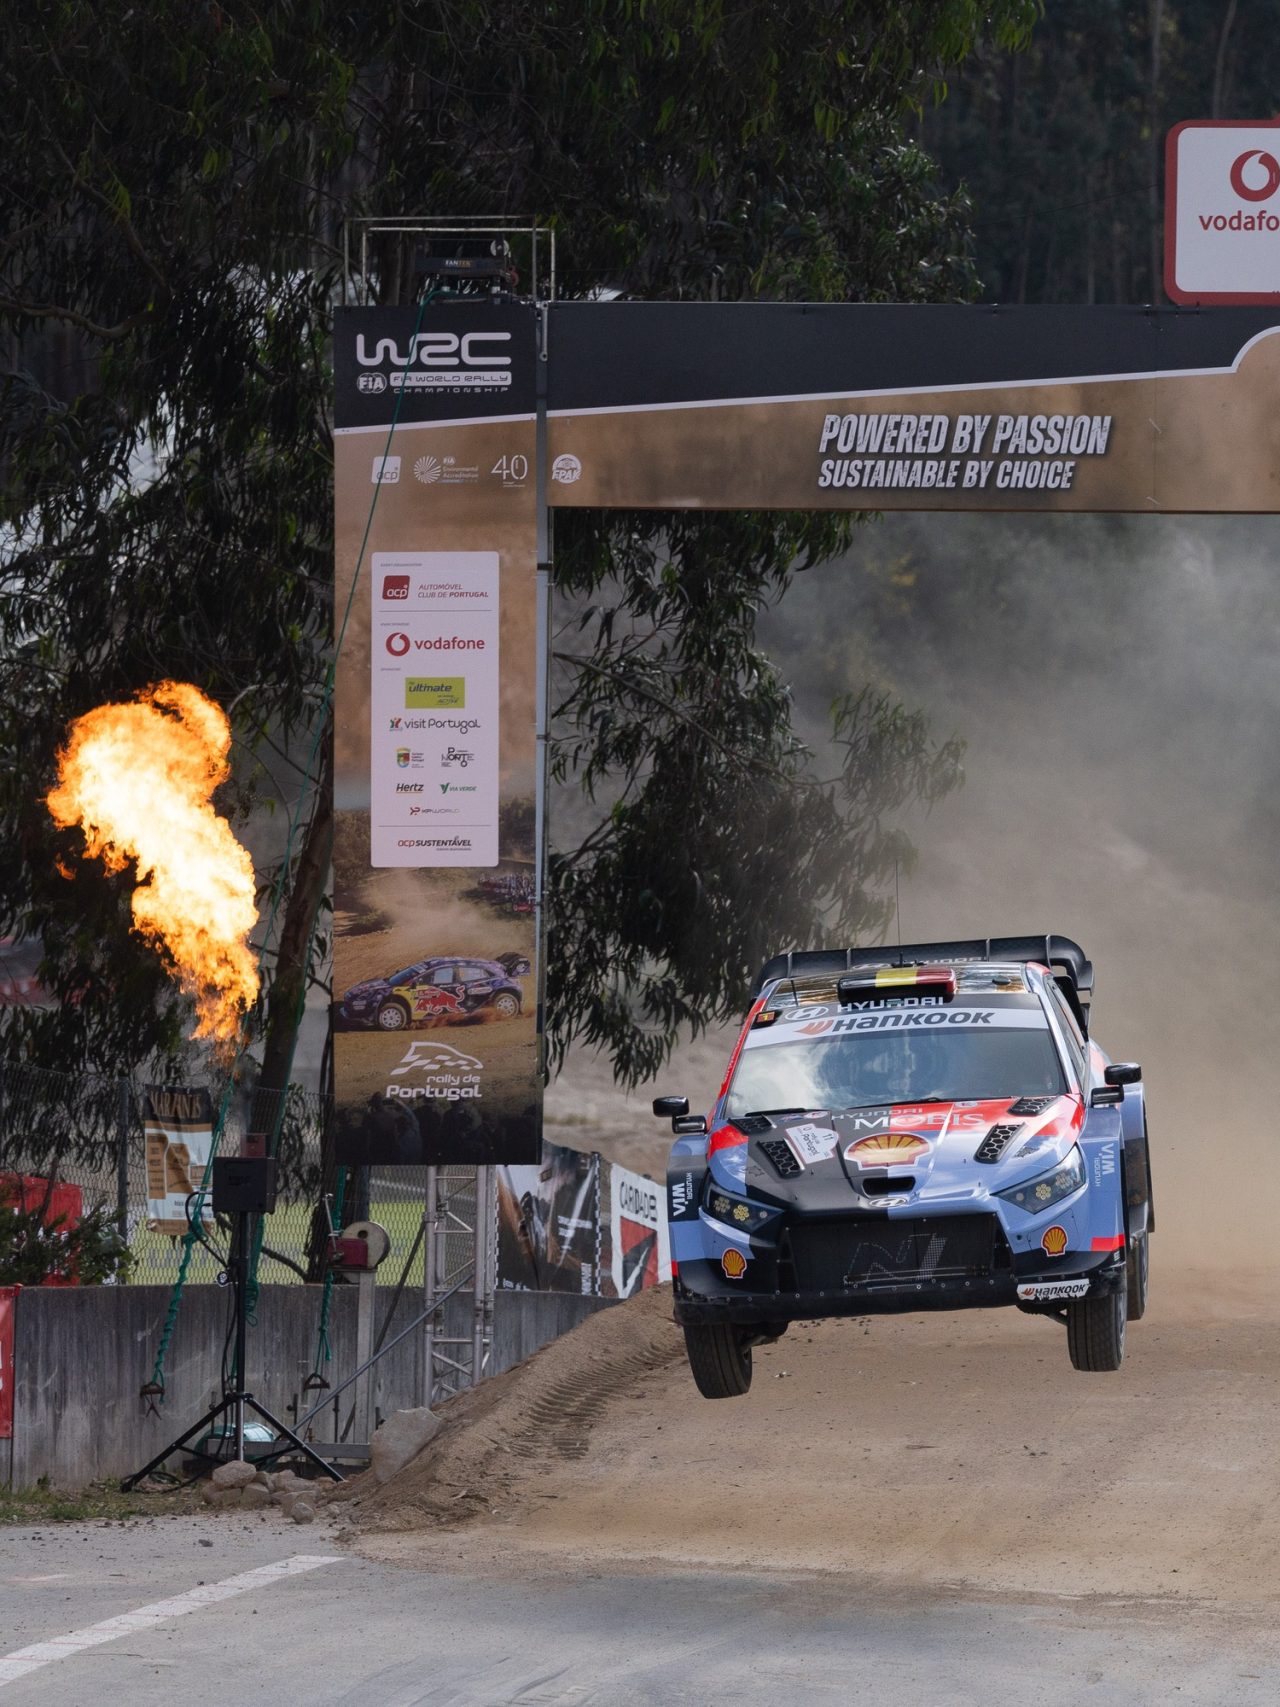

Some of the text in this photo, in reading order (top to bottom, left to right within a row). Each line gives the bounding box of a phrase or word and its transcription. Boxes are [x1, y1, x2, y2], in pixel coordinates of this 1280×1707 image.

[356, 332, 511, 366] WRC
[358, 376, 385, 391] FIA
[819, 414, 1112, 455] POWERED BY PASSION
[491, 454, 528, 481] 40
[818, 459, 1075, 489] SUSTAINABLE BY CHOICE
[386, 587, 408, 599] acp
[414, 636, 485, 650] vodafone
[408, 683, 452, 693] ultimate
[404, 718, 481, 734] visit Portugal
[396, 783, 424, 792] Hertz
[836, 996, 944, 1013] HYUNDAI
[426, 1074, 480, 1085] rally de
[385, 1084, 482, 1101] Portugal
[831, 1108, 923, 1120] HYUNDAI
[854, 1113, 985, 1130] MOBIS
